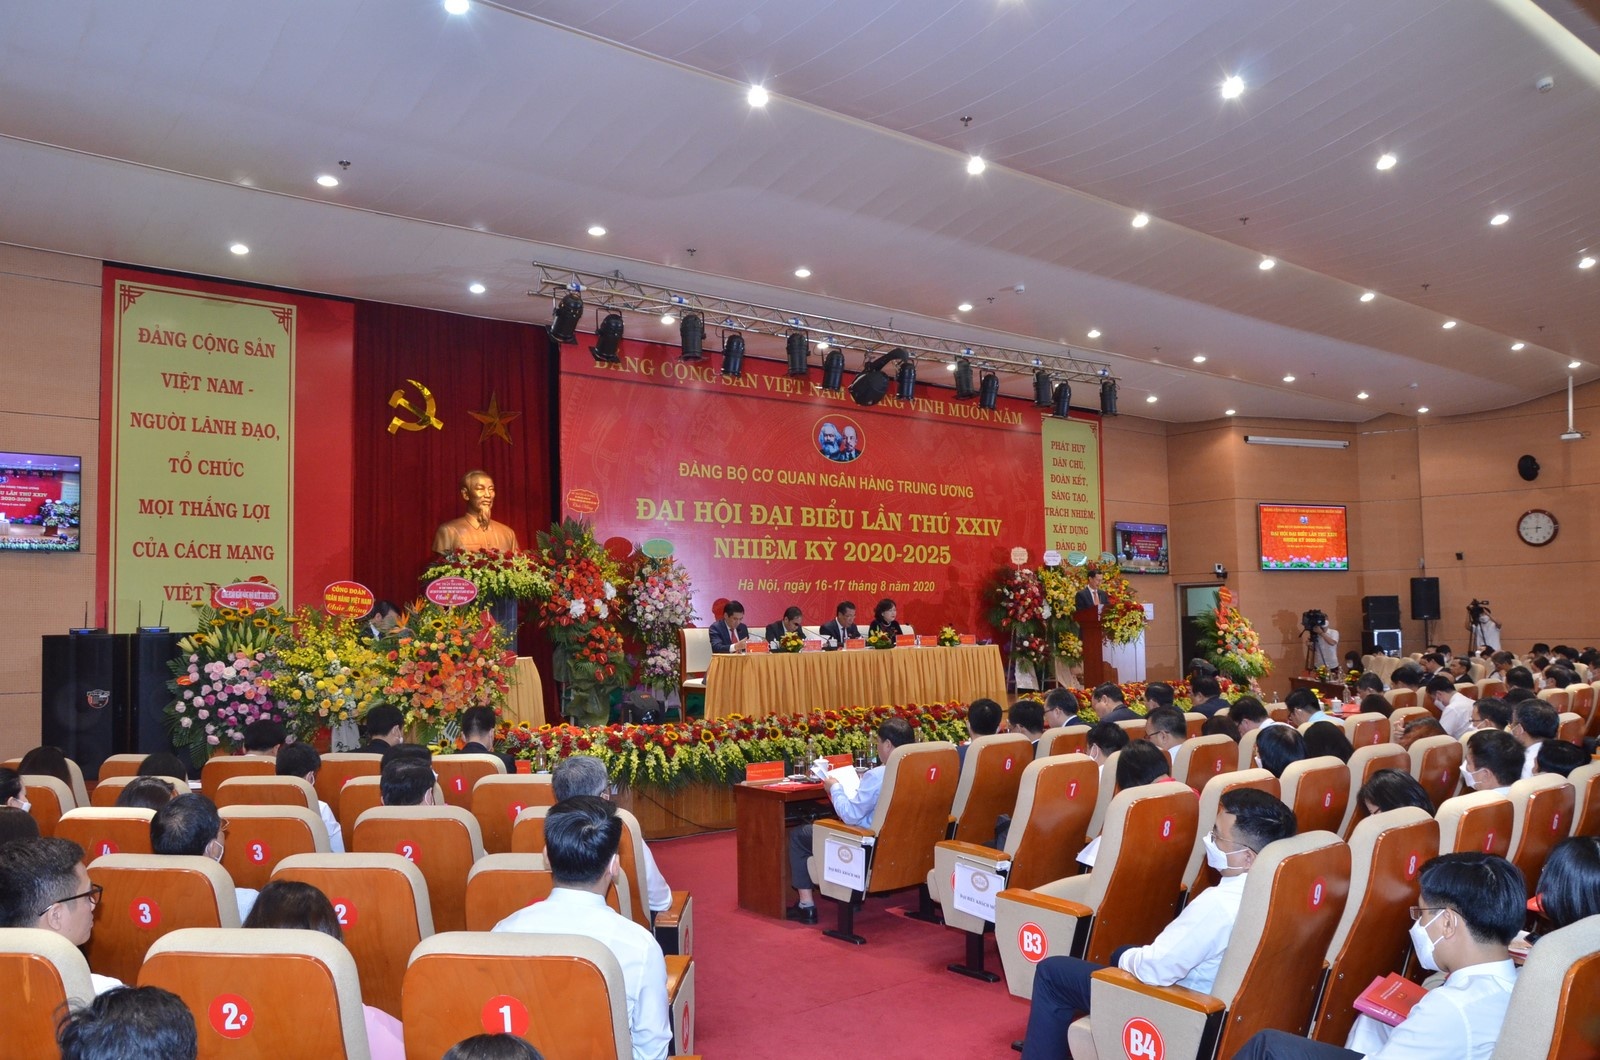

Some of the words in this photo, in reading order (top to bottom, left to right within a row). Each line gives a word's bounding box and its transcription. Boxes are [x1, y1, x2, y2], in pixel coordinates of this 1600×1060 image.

[138, 324, 187, 349] ĐẢNG
[193, 333, 239, 355] CỘNG
[244, 338, 275, 358] SẢN
[161, 372, 201, 393] VIỆT
[207, 377, 244, 395] NAM
[910, 397, 945, 415] VINH
[948, 402, 990, 421] MUÔN
[993, 407, 1023, 425] NĂM
[130, 411, 186, 432] NGƯỜI
[192, 416, 237, 436] LÃNH
[242, 423, 280, 441] ĐẠO,
[1050, 440, 1070, 451] PHÁT
[1071, 443, 1086, 453] HUY
[168, 451, 193, 474] TỔ
[198, 458, 244, 477] CHỨC
[679, 460, 723, 479] ĐẢNG
[727, 465, 748, 484] BỘ
[752, 468, 774, 483] CƠ
[777, 469, 816, 486] QUAN
[819, 471, 856, 489] NGÂN
[859, 475, 894, 492] HÀNG
[897, 480, 937, 495] TRUNG
[940, 484, 974, 498] ƯƠNG
[138, 498, 174, 519] MỌI
[179, 496, 238, 518] THẮNG
[242, 504, 271, 523] LỢI
[635, 497, 685, 526] ĐẠI
[693, 498, 743, 528] HỘI
[750, 504, 793, 531] ĐẠI
[800, 499, 855, 529] BIỂU
[861, 504, 903, 532] LẦN
[908, 512, 951, 535] THỨ
[955, 516, 1002, 537] XXIV
[132, 537, 169, 558] CỦA
[174, 540, 221, 559] CÁCH
[226, 544, 275, 563] MẠNG
[713, 534, 798, 564] NHIỆM
[804, 536, 838, 561] KỲ
[843, 542, 952, 565] 2020-2025
[163, 582, 204, 604] VIỆT
[737, 578, 754, 591] Hà
[757, 579, 780, 593] Nội,
[783, 580, 811, 594] ngày
[814, 580, 845, 591] 16-17
[848, 579, 877, 594] tháng
[880, 581, 886, 591] 8
[888, 581, 910, 592] năm
[913, 581, 935, 592] 2020
[930, 768, 938, 781] 7
[1006, 758, 1012, 770] 6
[456, 779, 463, 791] 1
[1070, 783, 1077, 797] 7
[1324, 793, 1331, 807] 6
[1163, 820, 1171, 837] 8
[253, 844, 263, 861] 3
[403, 845, 414, 861] 2
[1408, 855, 1417, 875] 8
[1313, 884, 1322, 905] 9
[139, 904, 152, 924] 3
[335, 904, 348, 925] 2
[1023, 931, 1042, 954] B3
[222, 1002, 241, 1030] 2
[499, 1005, 512, 1033] 1
[1129, 1028, 1156, 1060] B4
